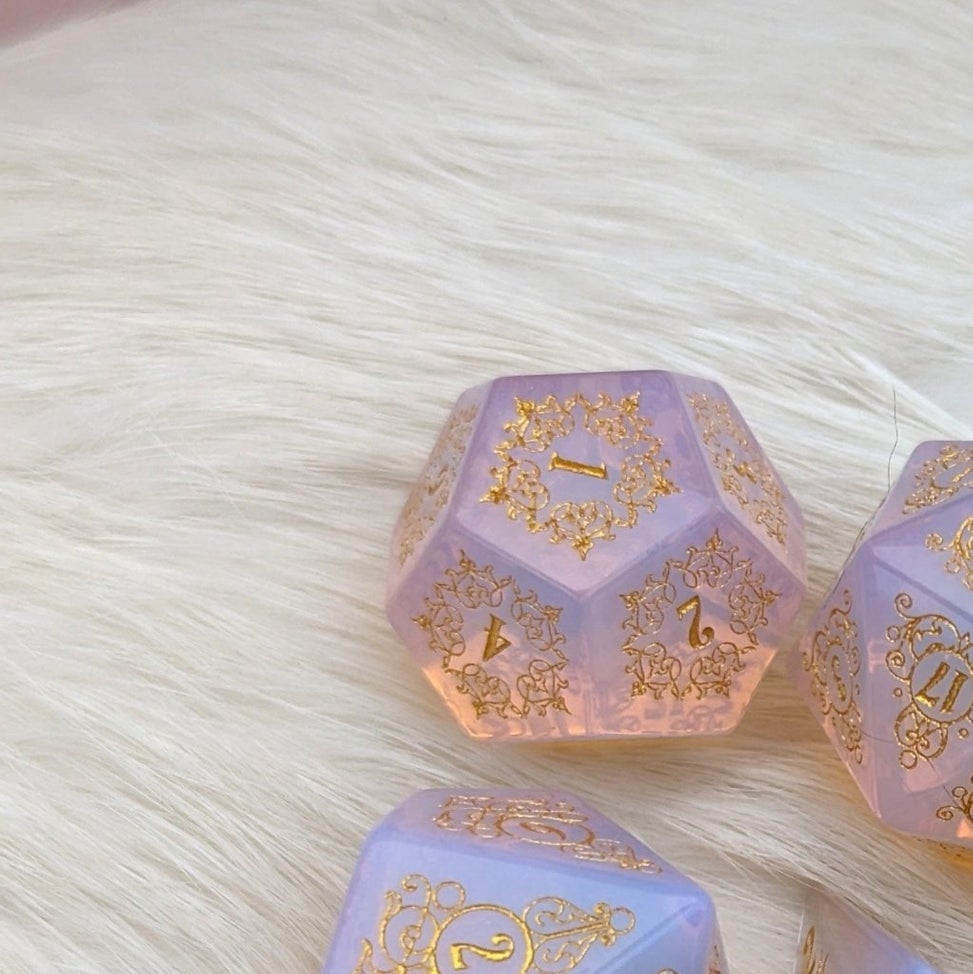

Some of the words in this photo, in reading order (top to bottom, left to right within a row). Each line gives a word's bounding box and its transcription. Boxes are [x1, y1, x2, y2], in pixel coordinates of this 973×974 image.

[548, 452, 609, 480] 1
[482, 613, 511, 662] 4
[676, 594, 715, 649] 2
[914, 659, 970, 715] 17
[449, 932, 516, 972] 2
